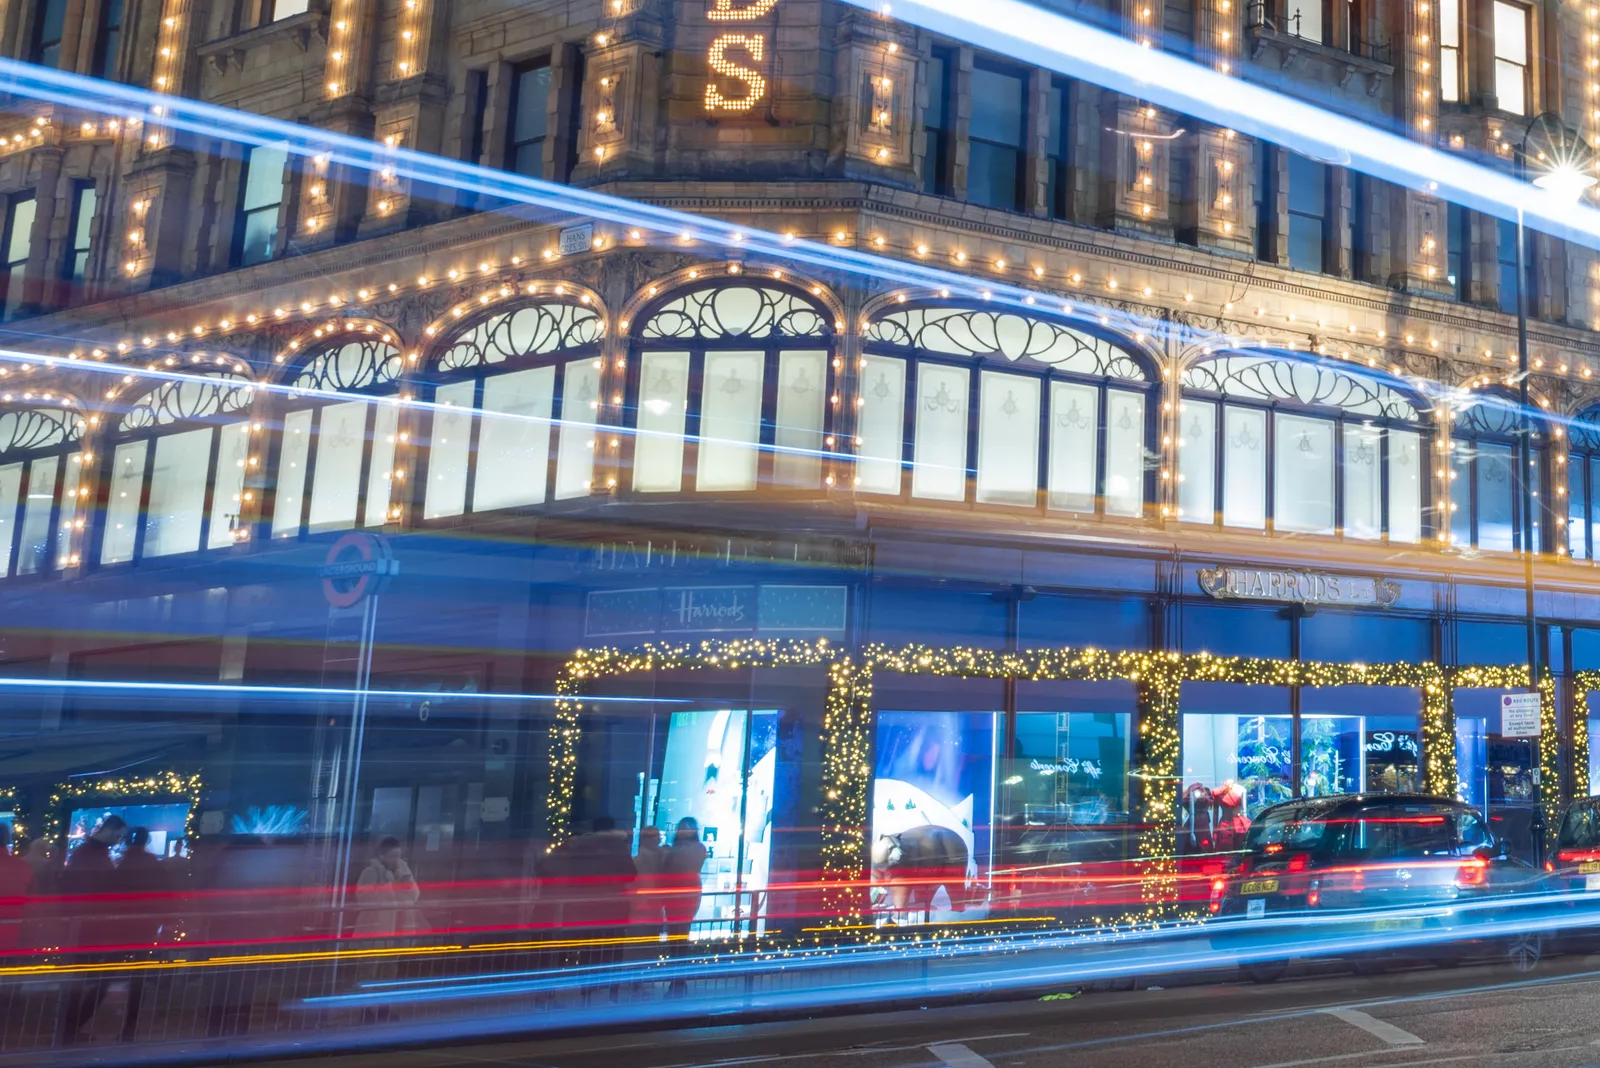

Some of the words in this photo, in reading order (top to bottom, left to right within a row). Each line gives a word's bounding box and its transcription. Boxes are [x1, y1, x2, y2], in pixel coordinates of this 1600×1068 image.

[566, 232, 586, 243] HANS
[319, 562, 376, 577] UNDERGROUND
[1231, 570, 1341, 601] HARRODS
[671, 589, 745, 622] Harrods
